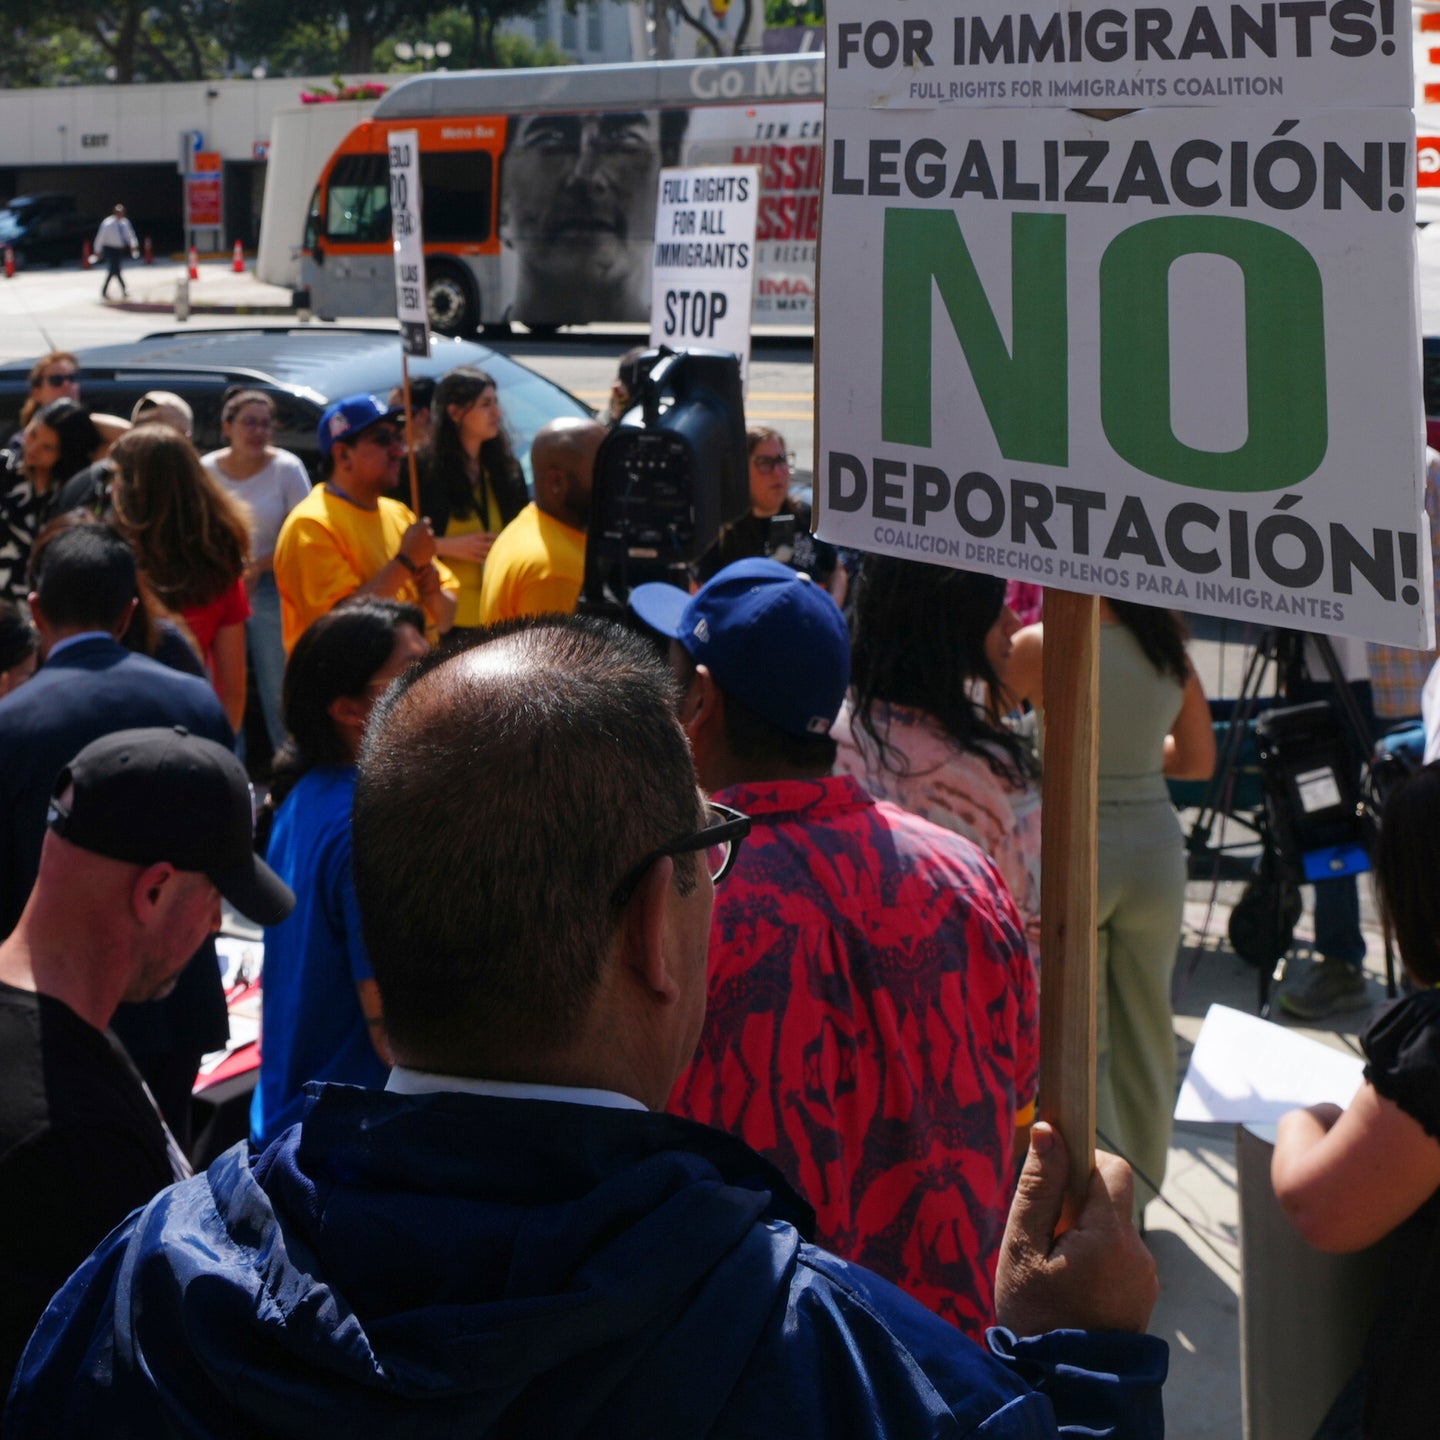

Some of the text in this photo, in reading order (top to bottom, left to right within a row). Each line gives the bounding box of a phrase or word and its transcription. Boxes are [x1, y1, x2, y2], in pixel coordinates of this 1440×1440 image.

[838, 19, 934, 69] FOR
[689, 62, 744, 100] Go
[909, 76, 1284, 99] FULL RIGHTS FOR IMMIGRANTS COALITION
[662, 177, 749, 204] FULL RIGHTS
[831, 119, 1406, 214] LEGALIZACIÓN!
[672, 210, 725, 236] FOR ALL
[664, 289, 728, 339] STOP
[881, 207, 1329, 493] NO
[828, 451, 1420, 606] DEPORTACIÓN!
[874, 527, 1345, 622] COALICION DERECHOS PLENOS PARA INMIGRANTES
